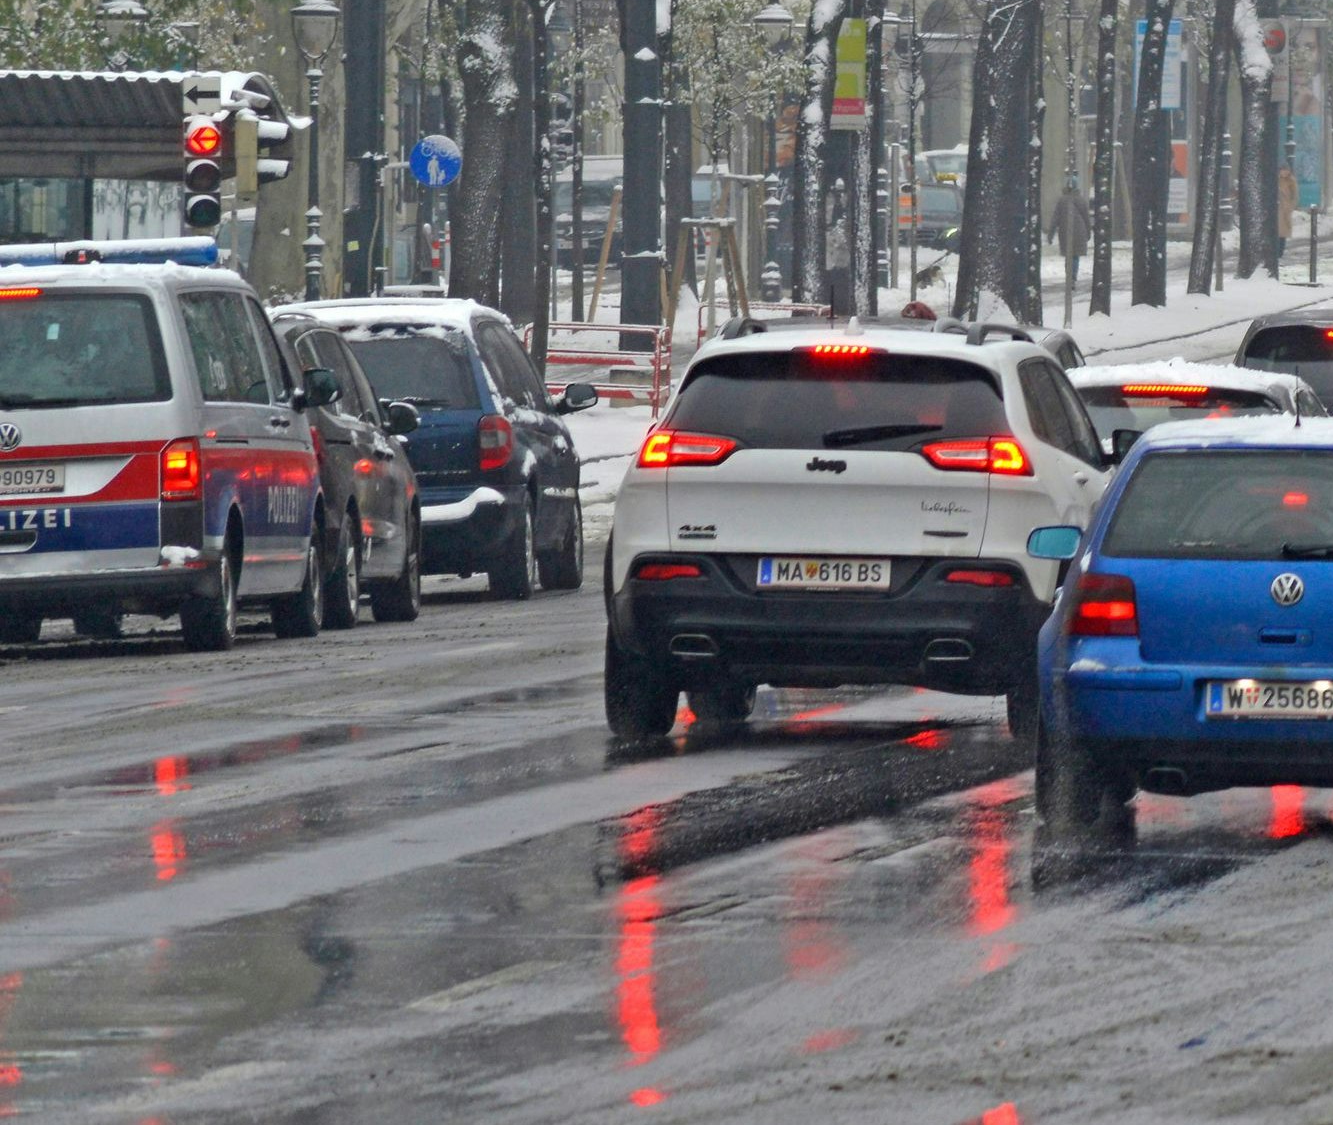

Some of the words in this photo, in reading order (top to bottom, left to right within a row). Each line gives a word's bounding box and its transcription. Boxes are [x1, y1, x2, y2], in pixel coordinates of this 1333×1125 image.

[806, 457, 848, 474] Jeep
[777, 560, 804, 582] MA
[818, 561, 852, 583] 616
[858, 562, 882, 583] BS
[1228, 687, 1244, 708] W
[1262, 687, 1333, 709] 25686
